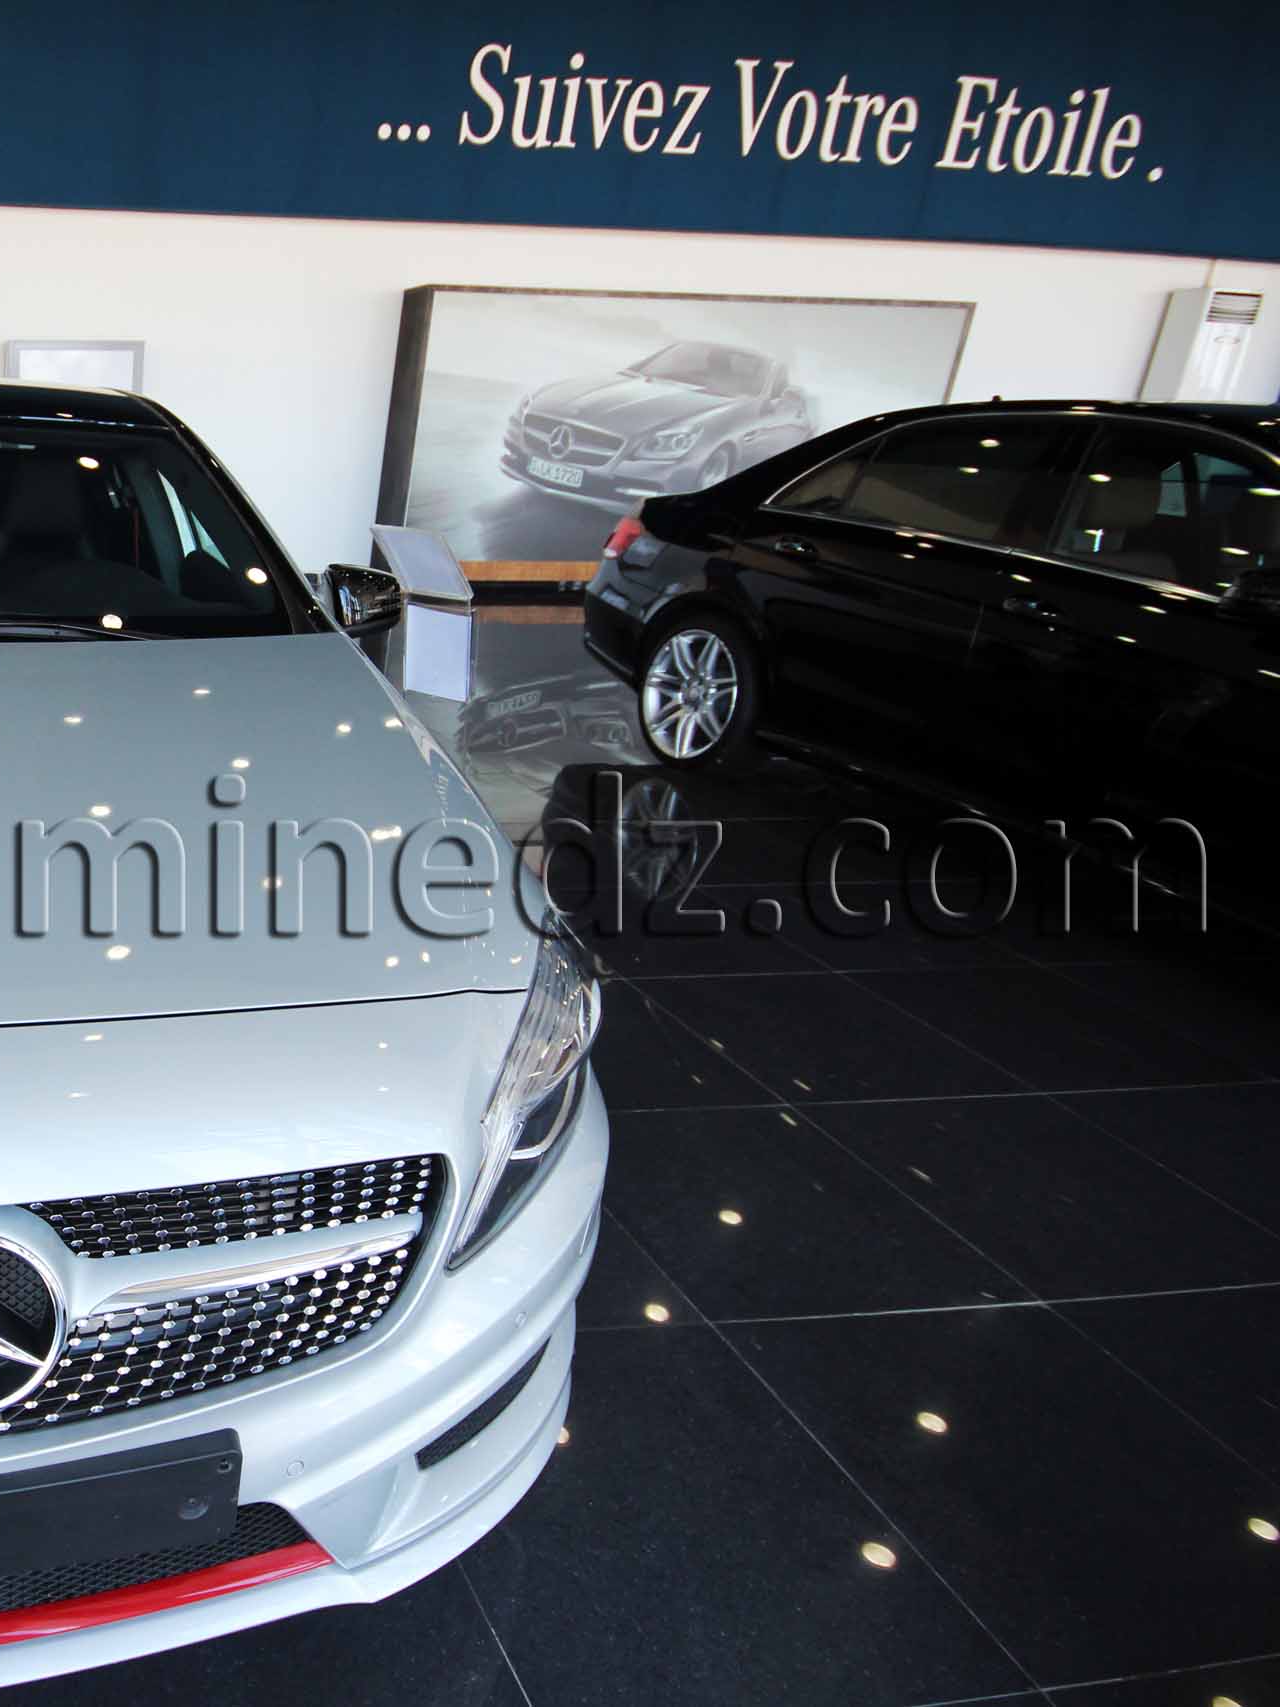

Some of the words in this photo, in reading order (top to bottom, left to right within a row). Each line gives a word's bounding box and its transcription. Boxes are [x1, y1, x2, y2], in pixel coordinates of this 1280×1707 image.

[459, 44, 710, 154] Suivez
[735, 59, 918, 165] Votre
[936, 76, 1162, 181] Etoile.
